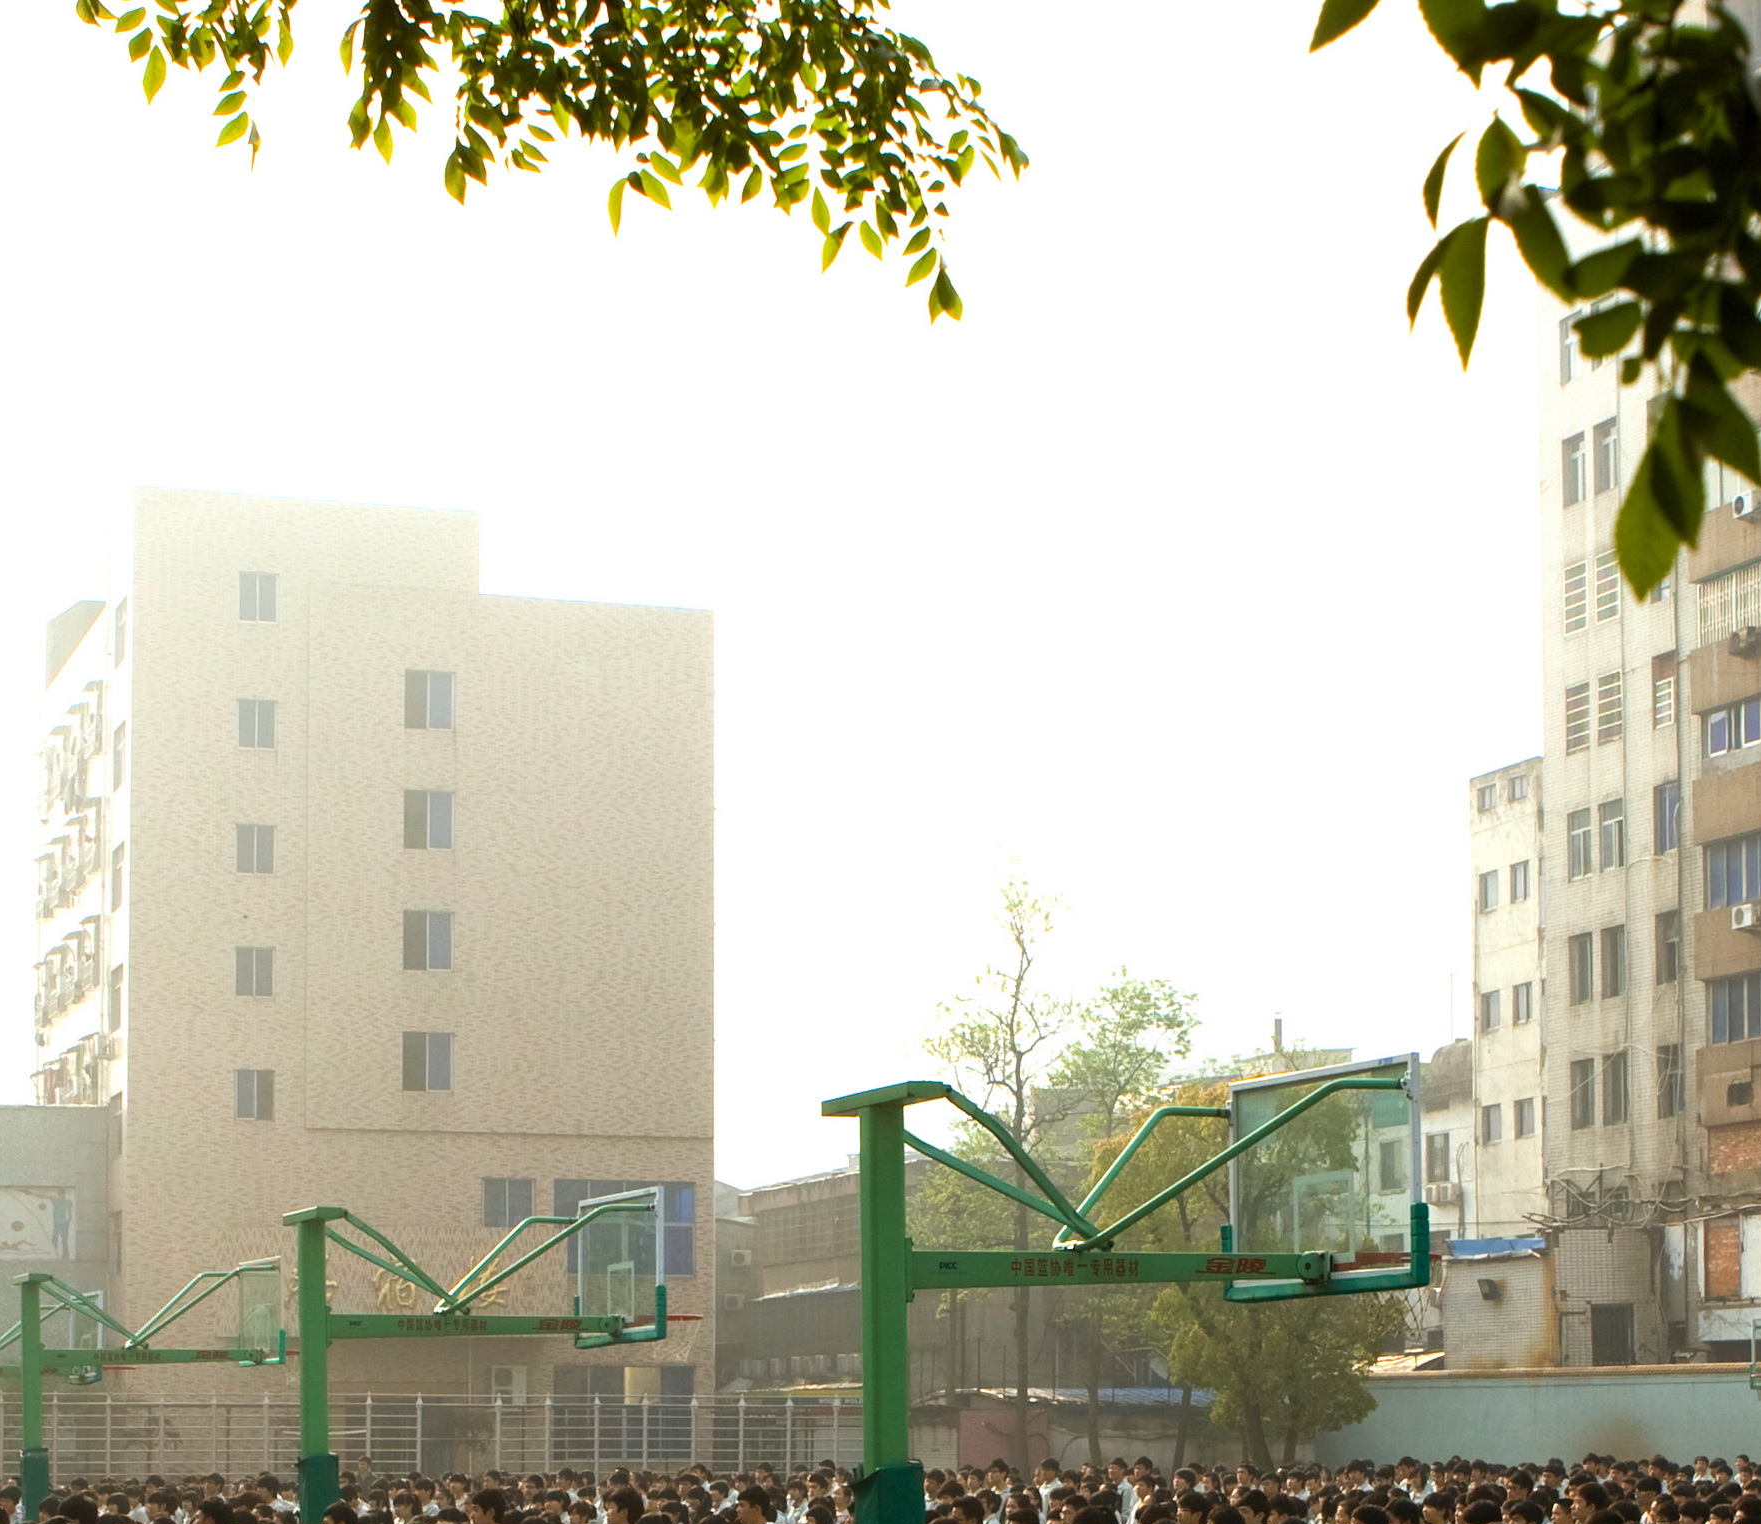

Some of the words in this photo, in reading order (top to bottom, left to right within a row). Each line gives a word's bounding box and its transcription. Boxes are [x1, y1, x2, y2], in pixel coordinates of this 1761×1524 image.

[938, 1260, 958, 1271] PICC
[1010, 1257, 1140, 1278] 中国篮协唯一专用器材
[1204, 1256, 1268, 1275] 金陵
